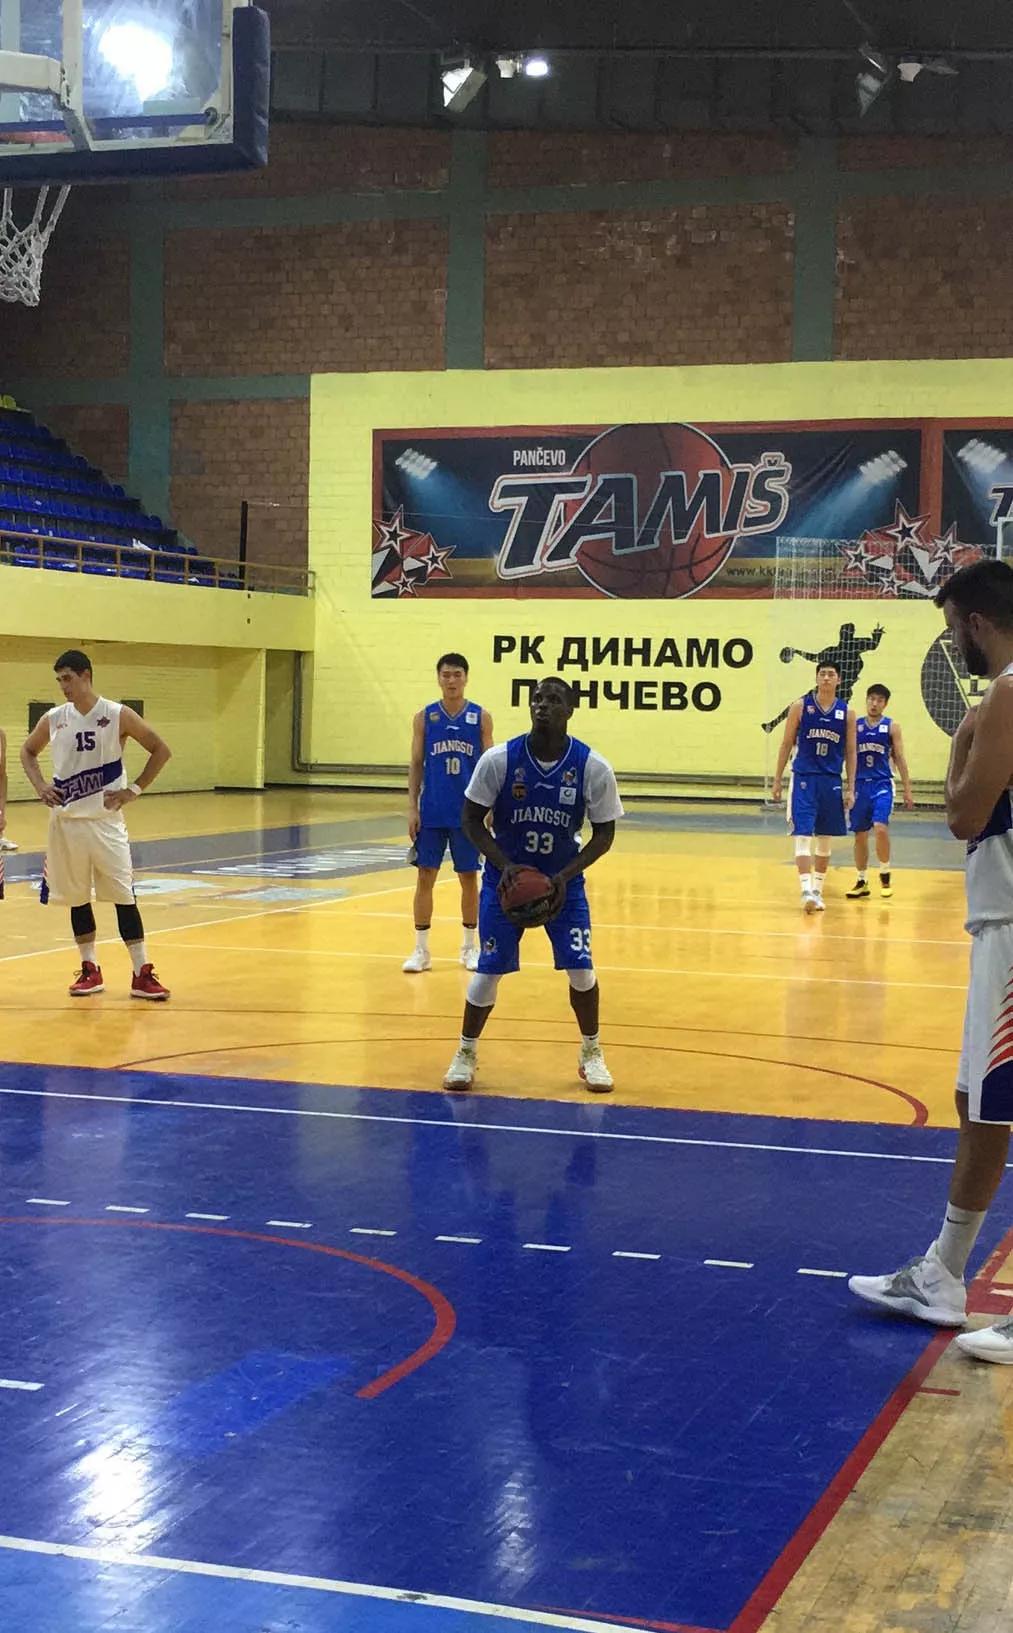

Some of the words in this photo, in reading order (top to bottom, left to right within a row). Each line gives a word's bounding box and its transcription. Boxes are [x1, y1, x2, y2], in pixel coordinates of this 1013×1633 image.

[513, 447, 566, 466] PANČEVO
[489, 452, 792, 579] TAMIŠ
[493, 635, 545, 664] РК
[557, 637, 754, 672] ДИНАМО
[511, 678, 722, 712] ПНЧЕВО
[75, 731, 96, 752] 15
[430, 740, 474, 756] JIANGSU
[445, 757, 460, 775] 10
[866, 755, 874, 767] 9
[511, 806, 572, 828] JIANGSU
[525, 831, 554, 854] 33
[569, 928, 591, 951] 33
